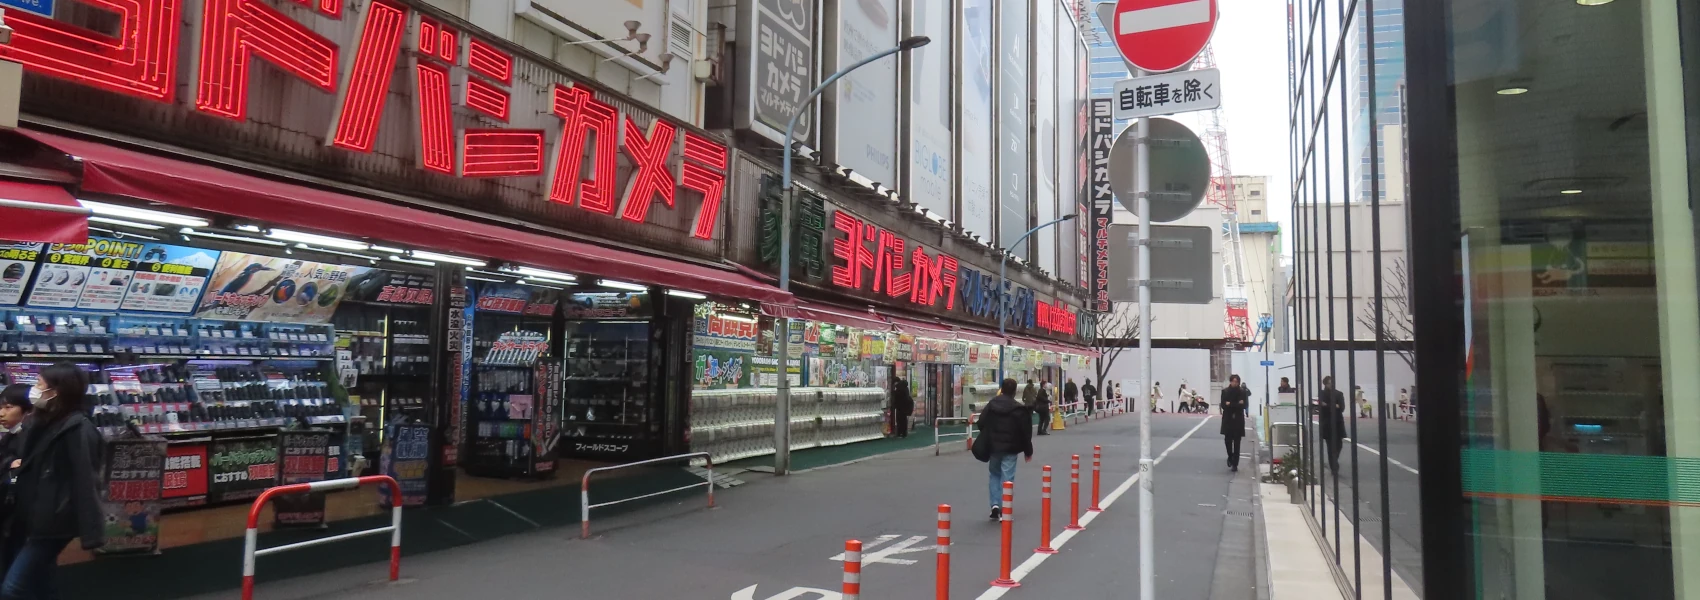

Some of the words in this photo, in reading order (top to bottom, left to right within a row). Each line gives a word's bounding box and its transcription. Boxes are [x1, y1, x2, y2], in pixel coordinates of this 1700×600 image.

[760, 23, 807, 76] ヨドバシ
[767, 61, 801, 103] カメラ
[1120, 79, 1213, 111] 自転車を除く
[760, 86, 805, 127] マルチメディ
[866, 143, 890, 170] PHILIPS
[914, 139, 947, 182] BIGLOBE
[1094, 101, 1112, 214] ヨドバシカメラ
[832, 210, 958, 310] ヨドバシカメラ
[376, 284, 435, 305] 高級双眼
[575, 442, 629, 453] フィールドスコープ
